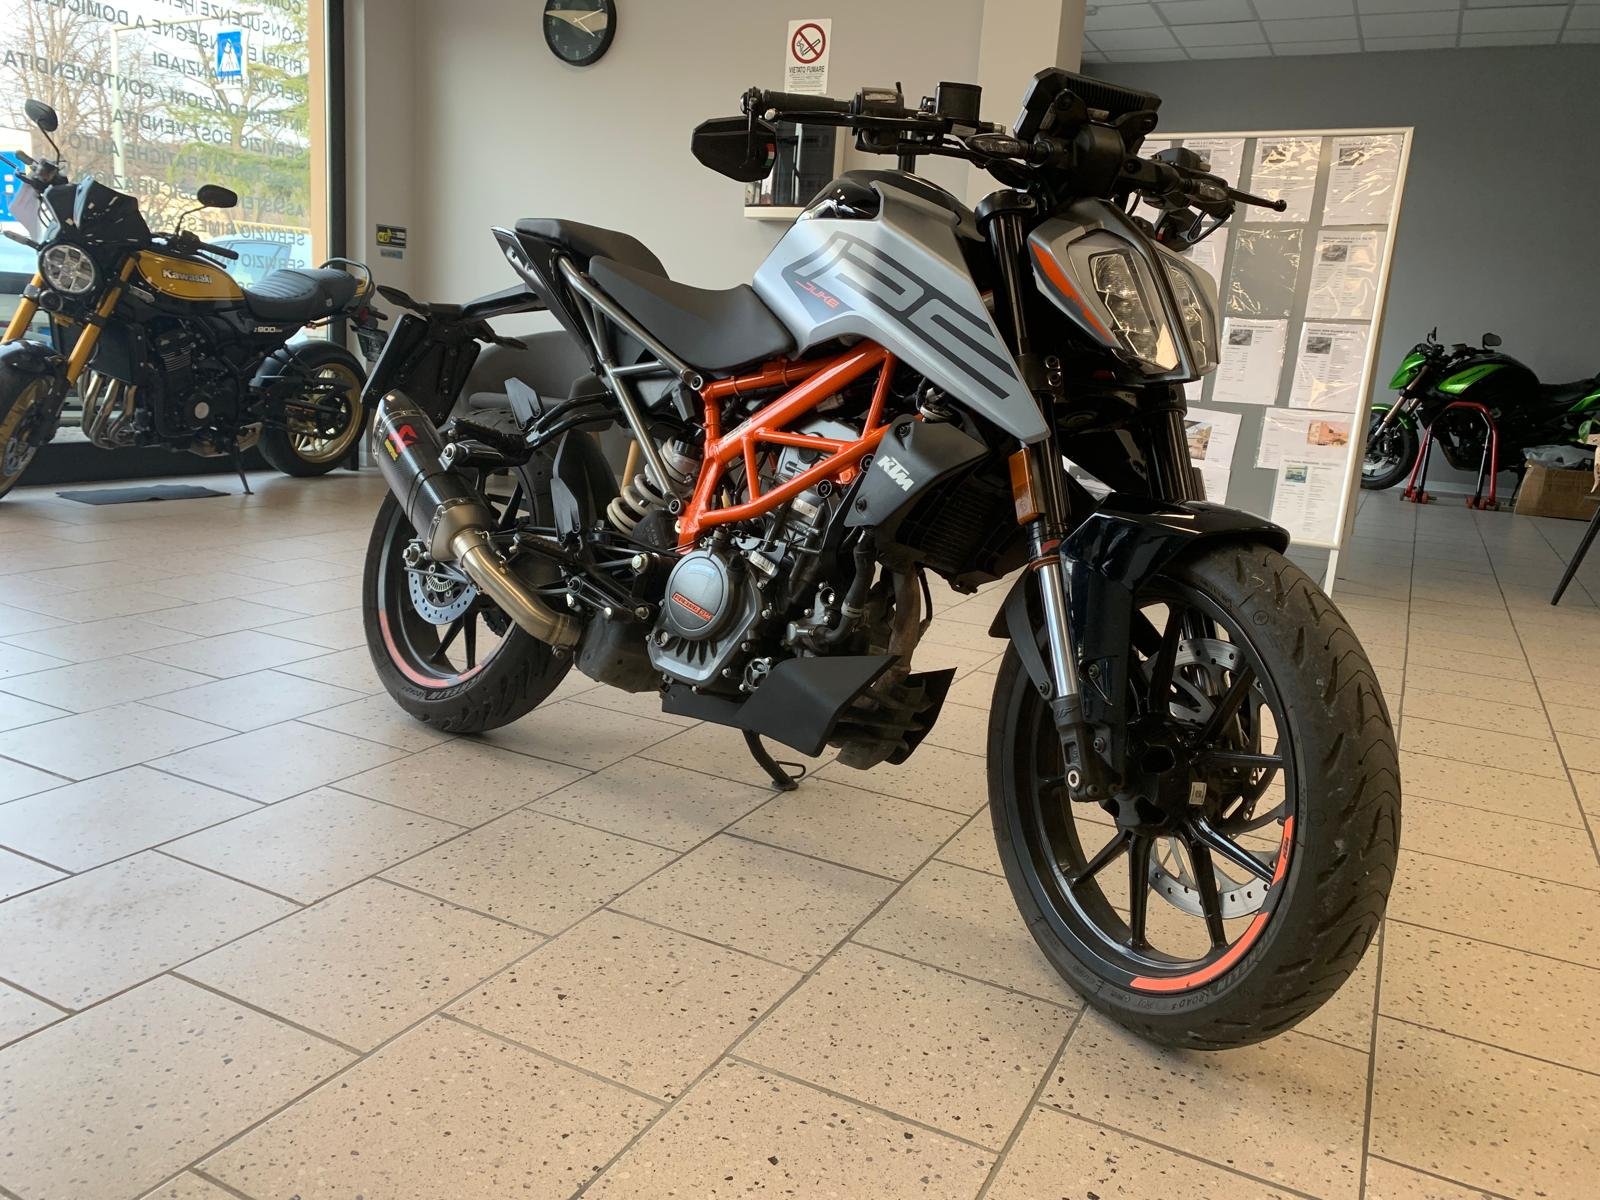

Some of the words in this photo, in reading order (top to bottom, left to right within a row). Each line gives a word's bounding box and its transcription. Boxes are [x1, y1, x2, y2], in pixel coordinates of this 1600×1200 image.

[162, 268, 212, 284] Kawasaki
[794, 280, 840, 309] DUKE
[877, 455, 915, 491] KTM
